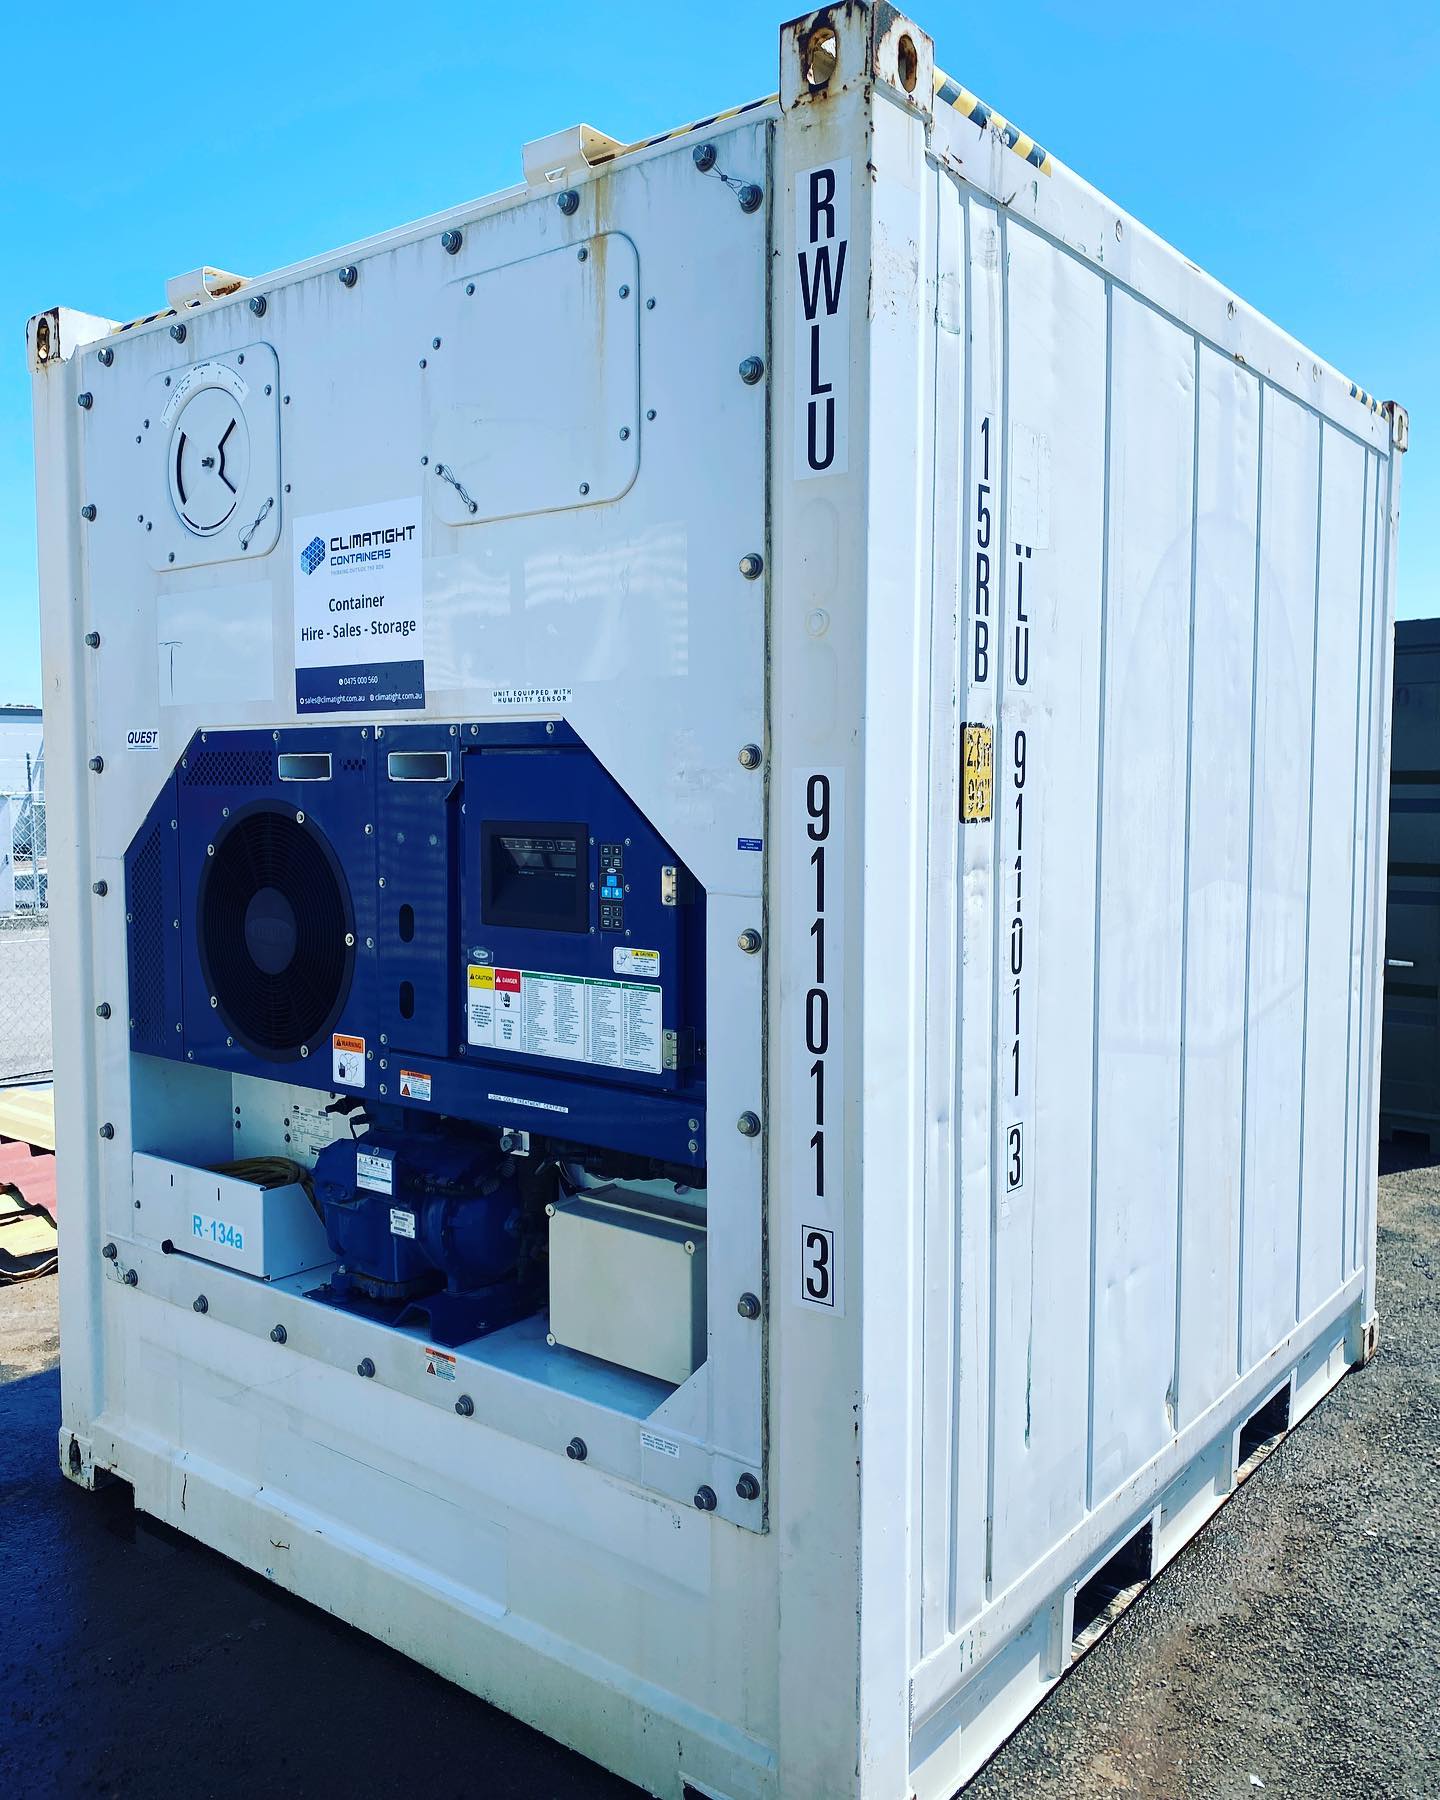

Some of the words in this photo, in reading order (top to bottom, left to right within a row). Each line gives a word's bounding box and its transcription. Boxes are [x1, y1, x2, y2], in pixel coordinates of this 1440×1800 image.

[798, 168, 848, 471] RWLU
[330, 525, 416, 552] CLIMATIGHT
[974, 416, 991, 683] 15RB
[330, 548, 391, 567] CONTAINERS
[328, 594, 385, 612] Container
[1014, 542, 1032, 687] LU
[301, 626, 324, 642] Hire
[333, 623, 362, 639] Sales
[371, 620, 416, 637] Storage
[343, 678, 357, 686] 0475
[357, 677, 367, 685] 000
[513, 689, 549, 697] EQUIPPED
[304, 694, 366, 705] sales@climatight.com.au
[374, 692, 423, 703] climatight.com.au
[537, 695, 567, 703] SENSOR
[127, 731, 158, 744] QUEST
[1010, 730, 1027, 1097] 911011
[475, 974, 492, 982] CAUTION
[805, 774, 830, 1198] 911011
[1008, 1128, 1021, 1187] 3
[192, 1214, 244, 1250] R-134a
[805, 1231, 829, 1300] 3
